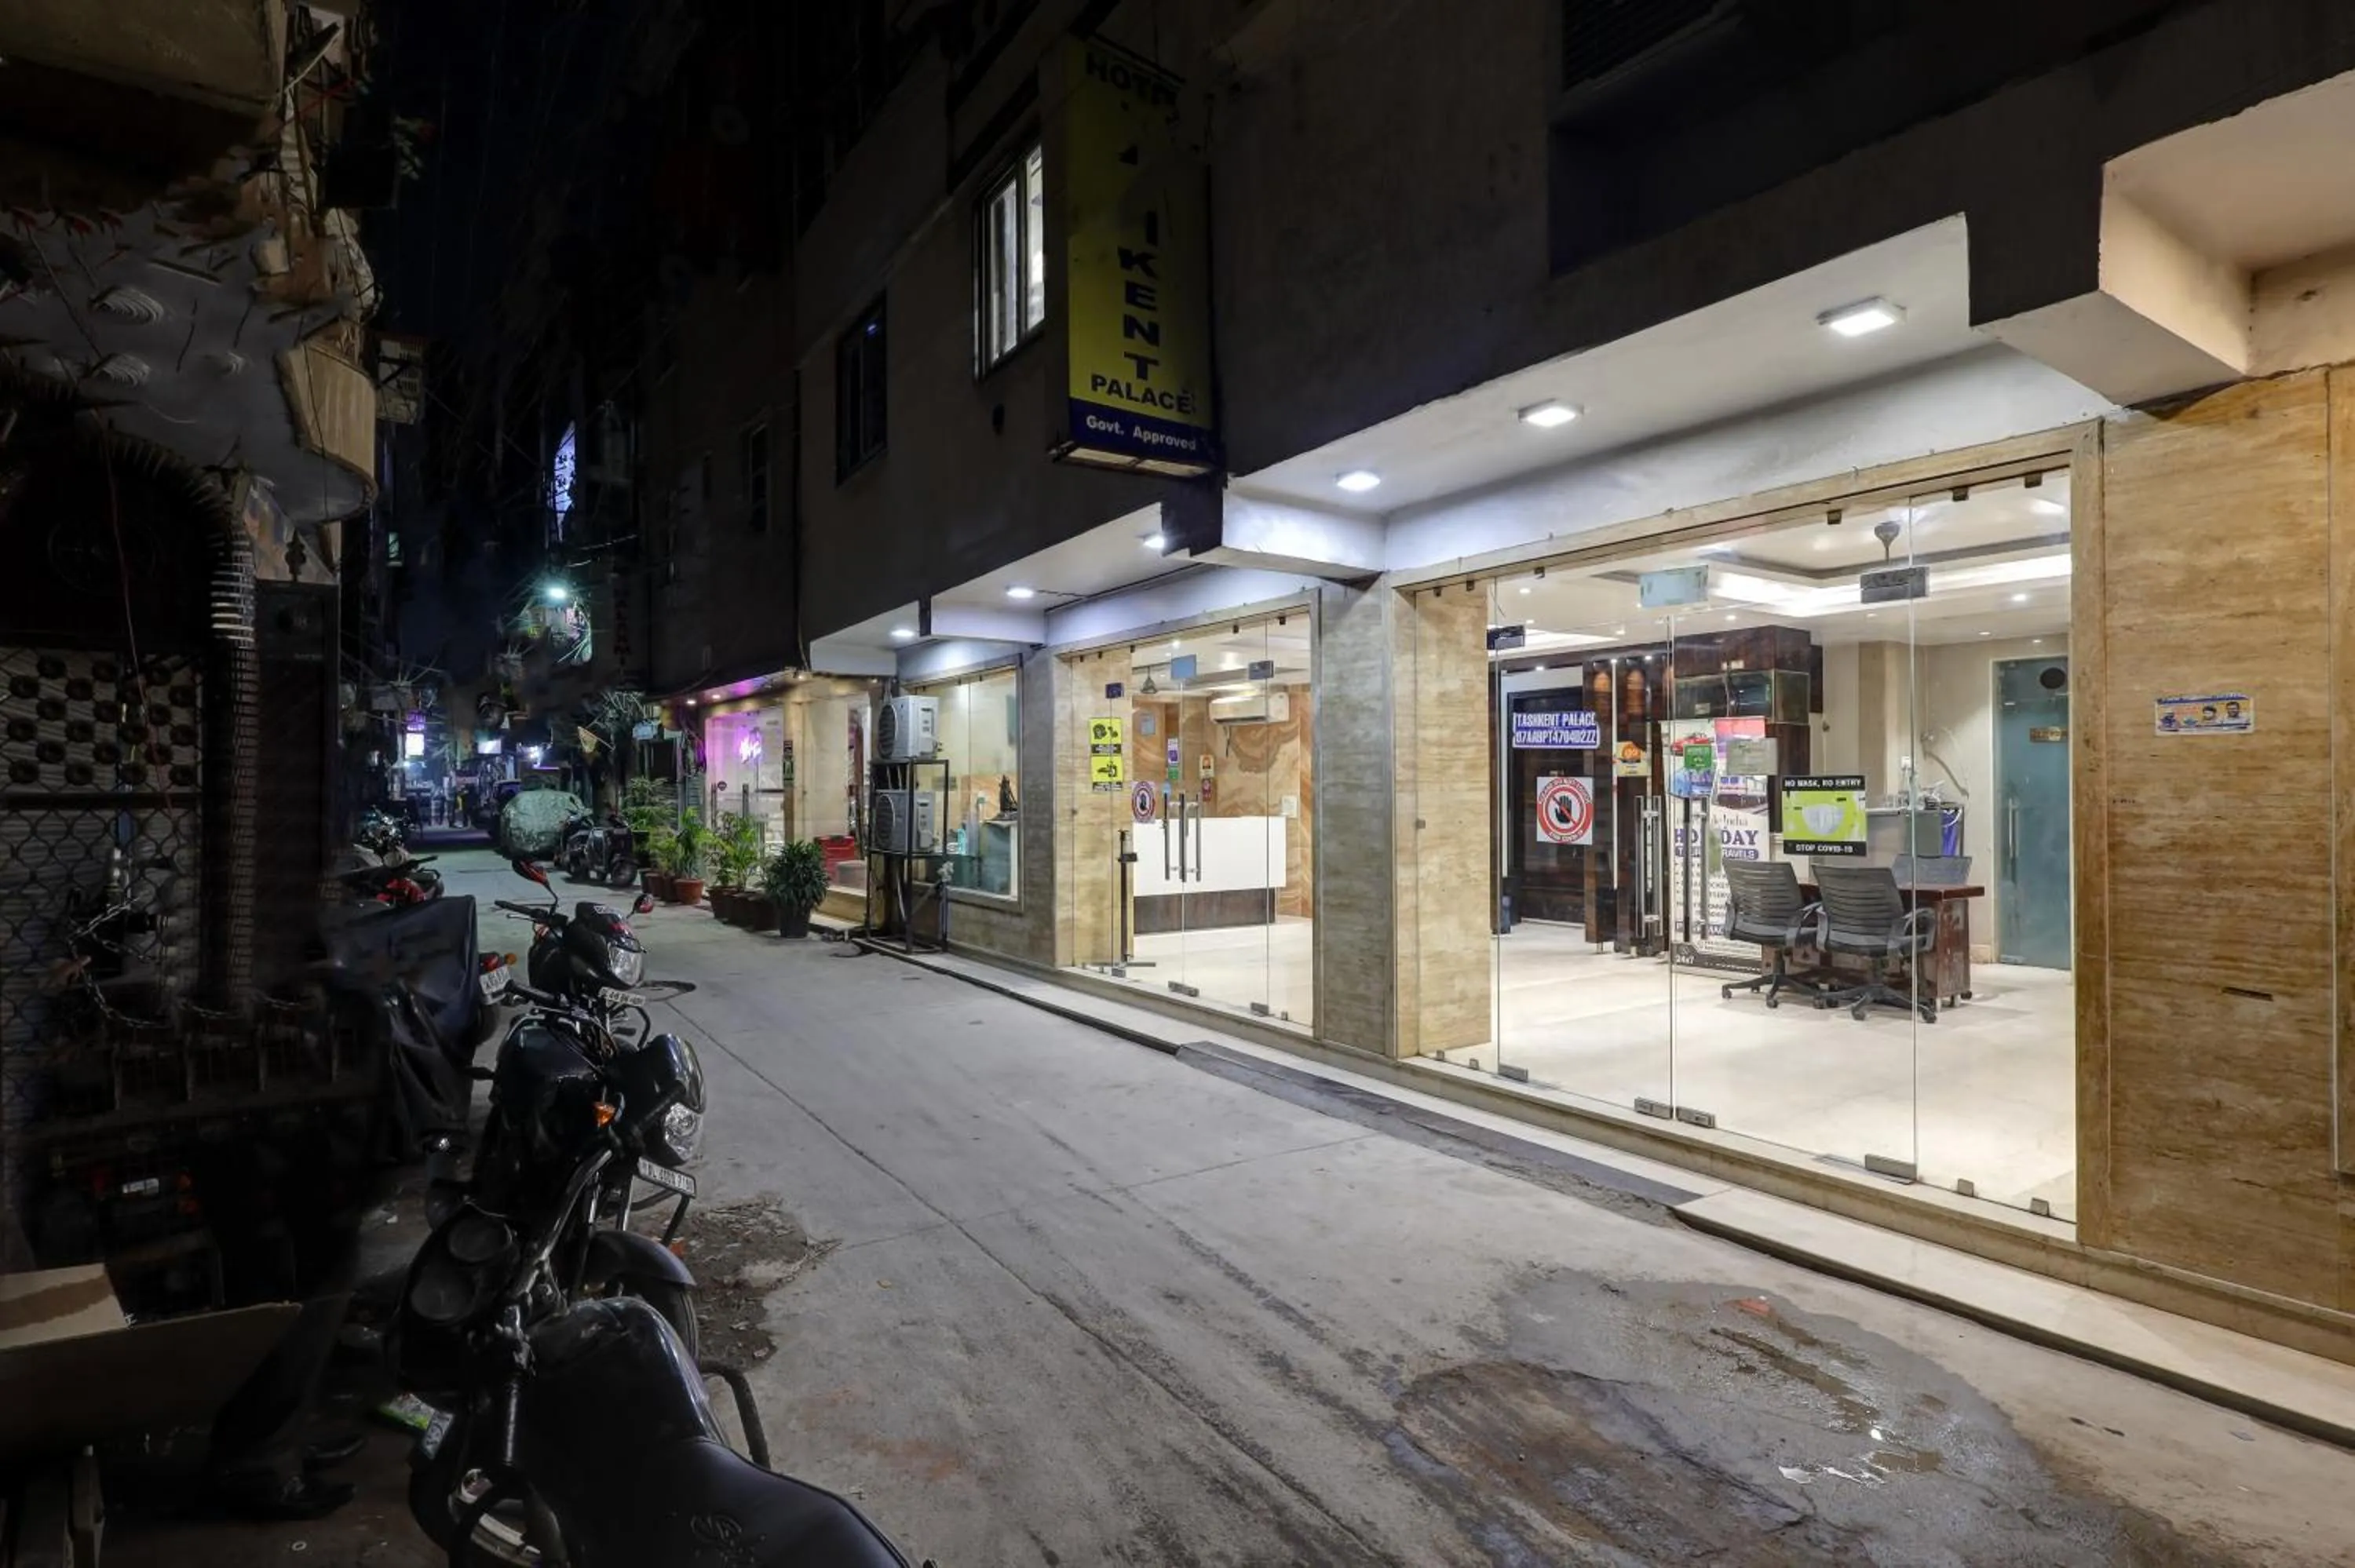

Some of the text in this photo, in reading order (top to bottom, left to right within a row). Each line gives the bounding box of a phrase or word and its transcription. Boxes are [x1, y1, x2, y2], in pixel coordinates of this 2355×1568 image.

[1091, 374, 1192, 414] PALACE
[1086, 415, 1196, 451] Govt. Approved
[1517, 712, 1596, 727] TASHKENT PALACE
[1817, 844, 1853, 853] COVID-19
